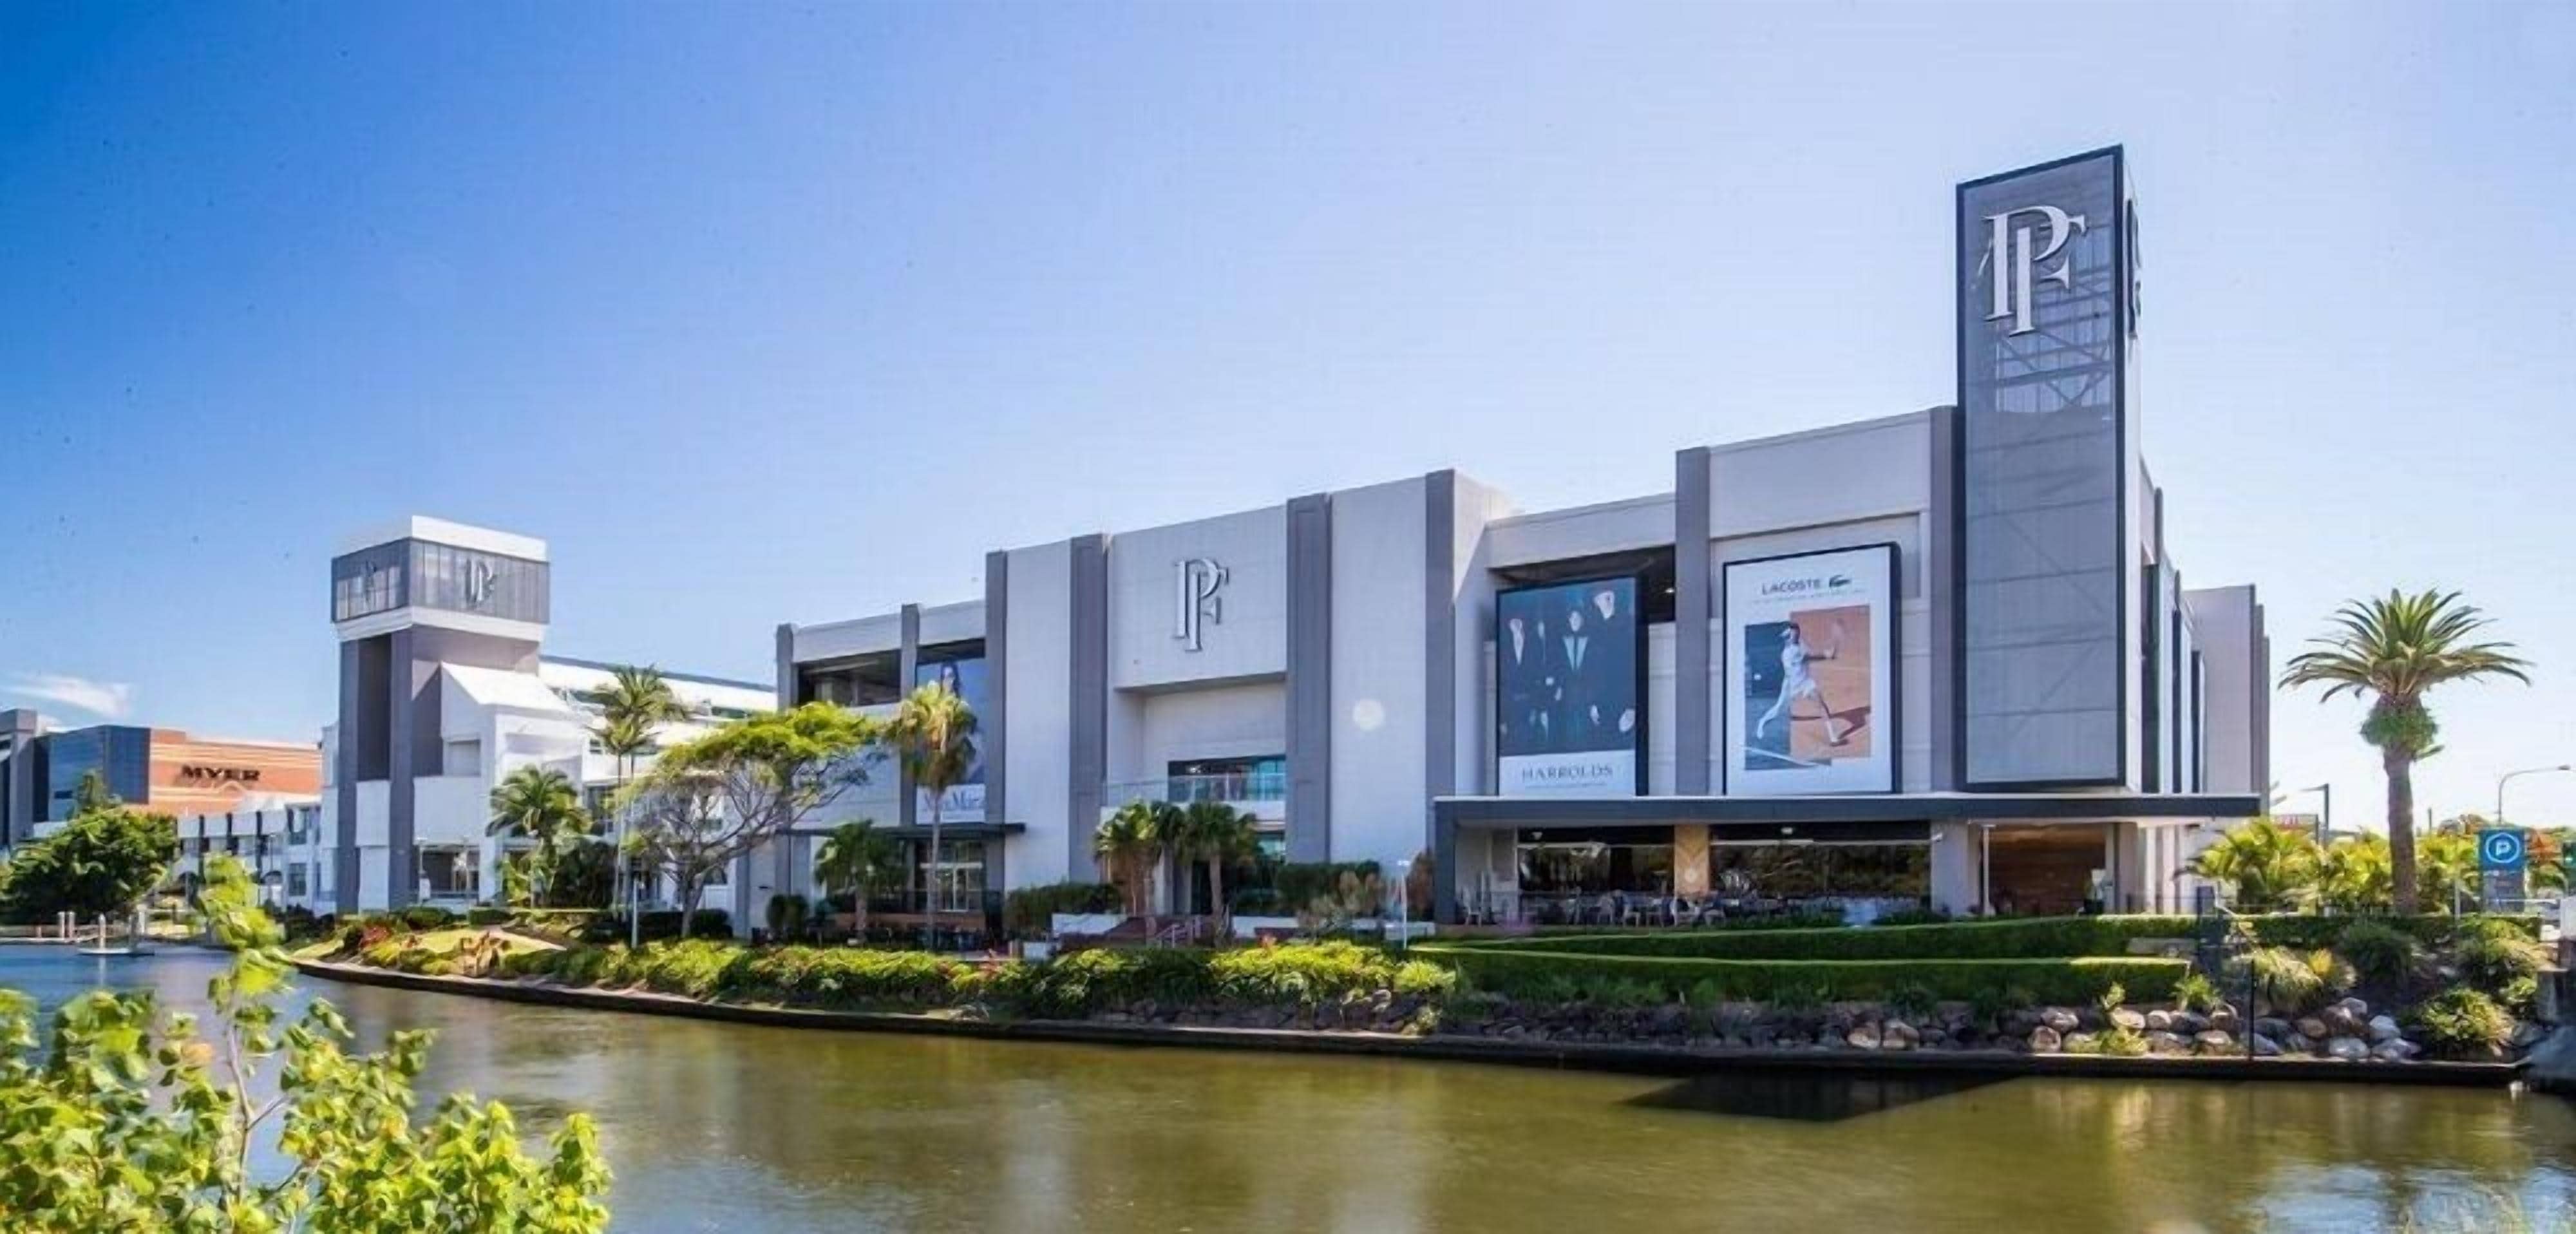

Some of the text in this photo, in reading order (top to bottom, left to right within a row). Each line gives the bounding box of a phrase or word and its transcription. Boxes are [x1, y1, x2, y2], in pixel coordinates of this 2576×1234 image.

[1762, 579, 1821, 596] LACOSTE
[182, 764, 260, 781] MYER
[1522, 764, 1613, 782] HARROLDS
[2496, 840, 2511, 856] P
